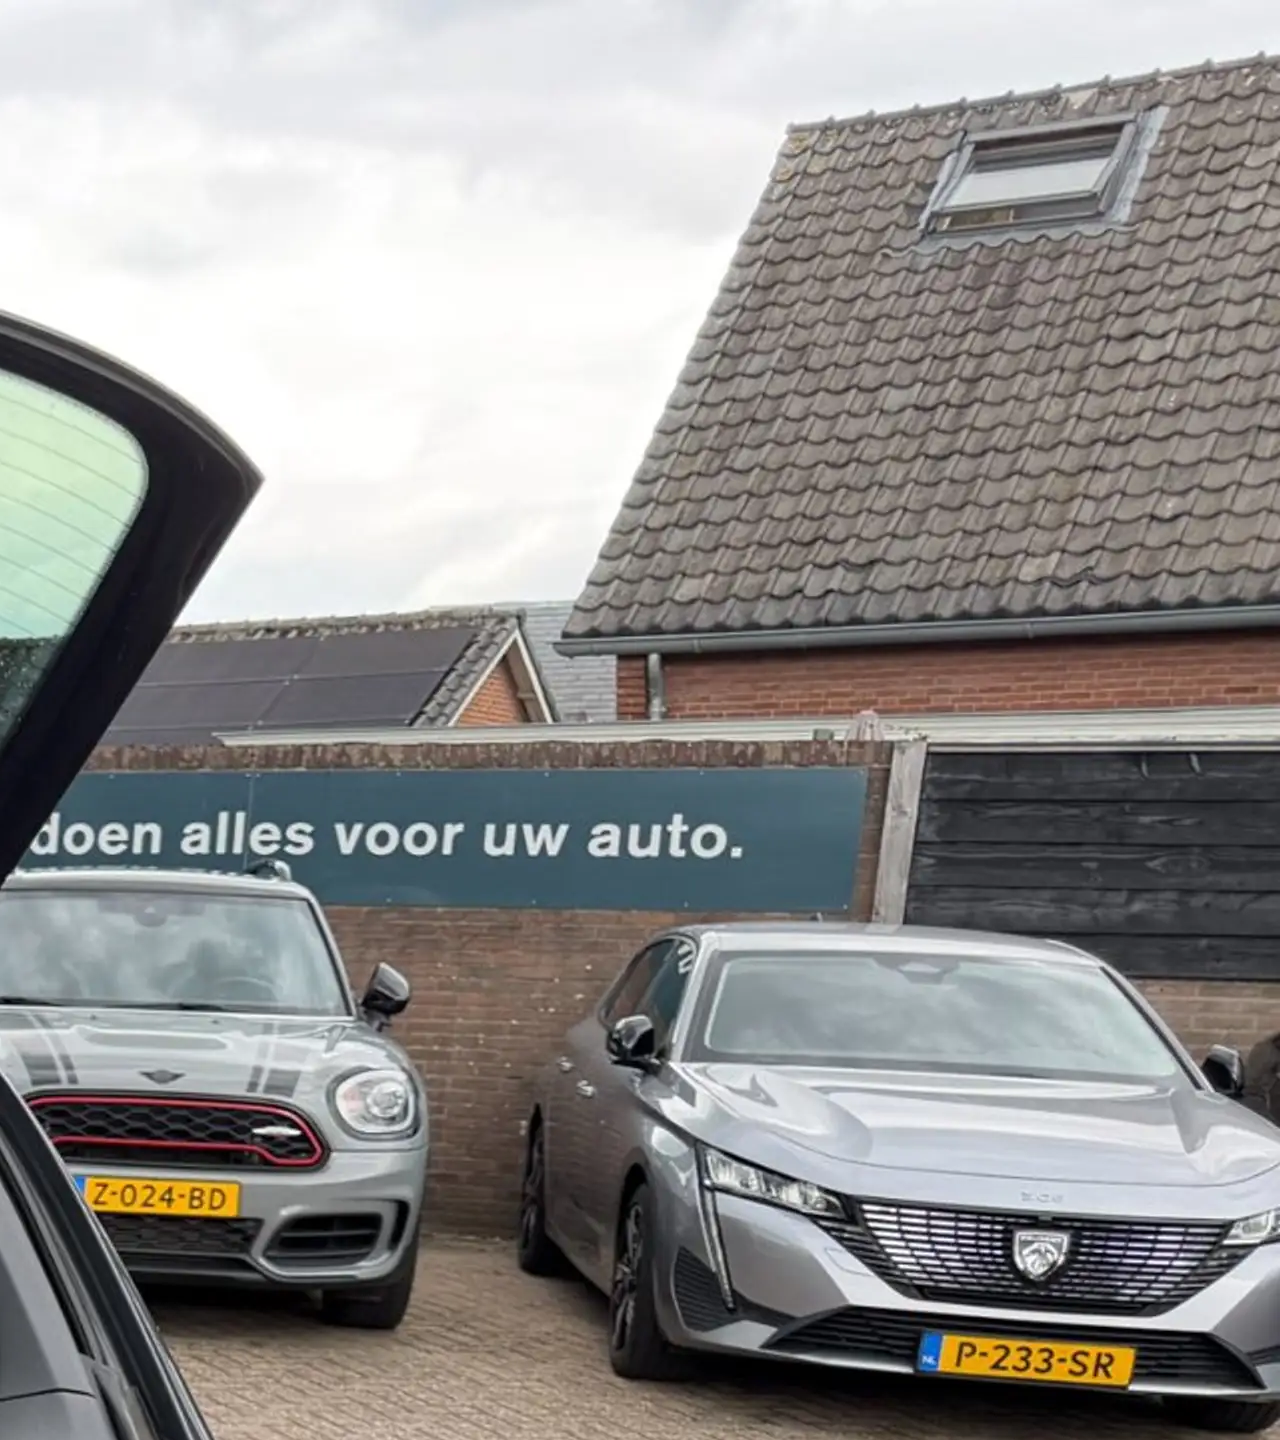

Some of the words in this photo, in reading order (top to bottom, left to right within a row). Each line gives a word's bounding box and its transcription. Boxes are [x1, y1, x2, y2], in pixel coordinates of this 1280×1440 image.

[29, 811, 162, 856] doen
[180, 811, 315, 856] alles
[334, 821, 465, 856] voor
[483, 822, 570, 857] uw
[587, 812, 744, 859] auto.
[91, 1181, 227, 1211] Z-024-BD
[954, 1341, 1116, 1380] P-233-SR
